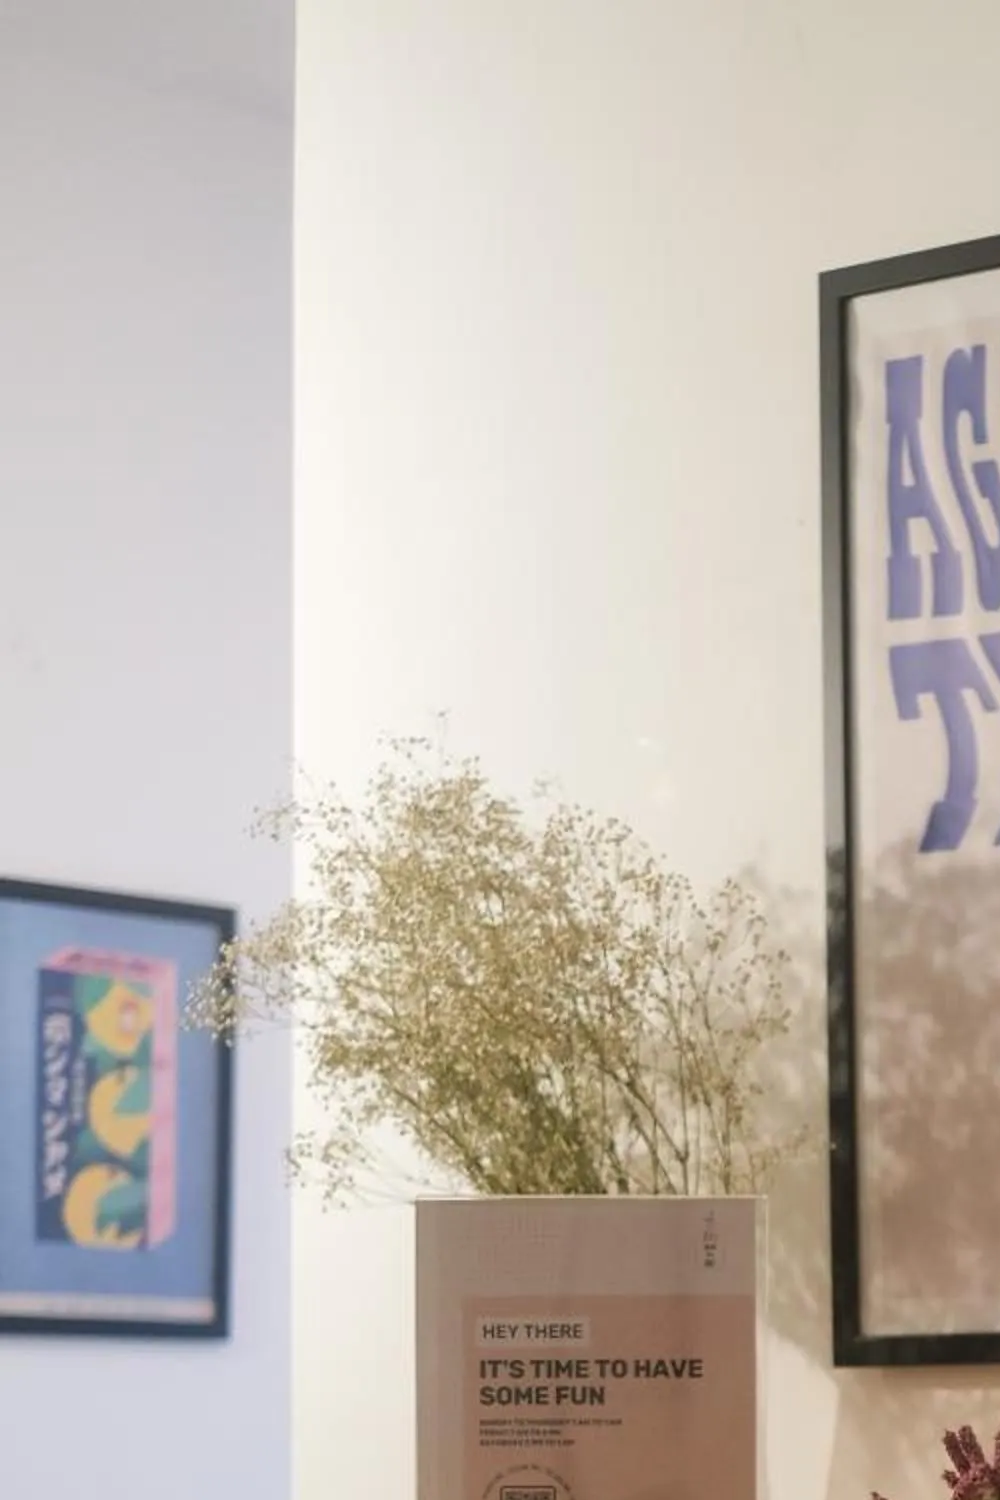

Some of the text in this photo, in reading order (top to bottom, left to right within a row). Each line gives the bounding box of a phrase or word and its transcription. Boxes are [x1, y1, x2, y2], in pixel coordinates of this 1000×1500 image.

[482, 1323, 584, 1339] HEY THERE
[480, 1359, 704, 1379] IT'S TIME TO HAVE
[479, 1386, 606, 1406] SOME FUN
